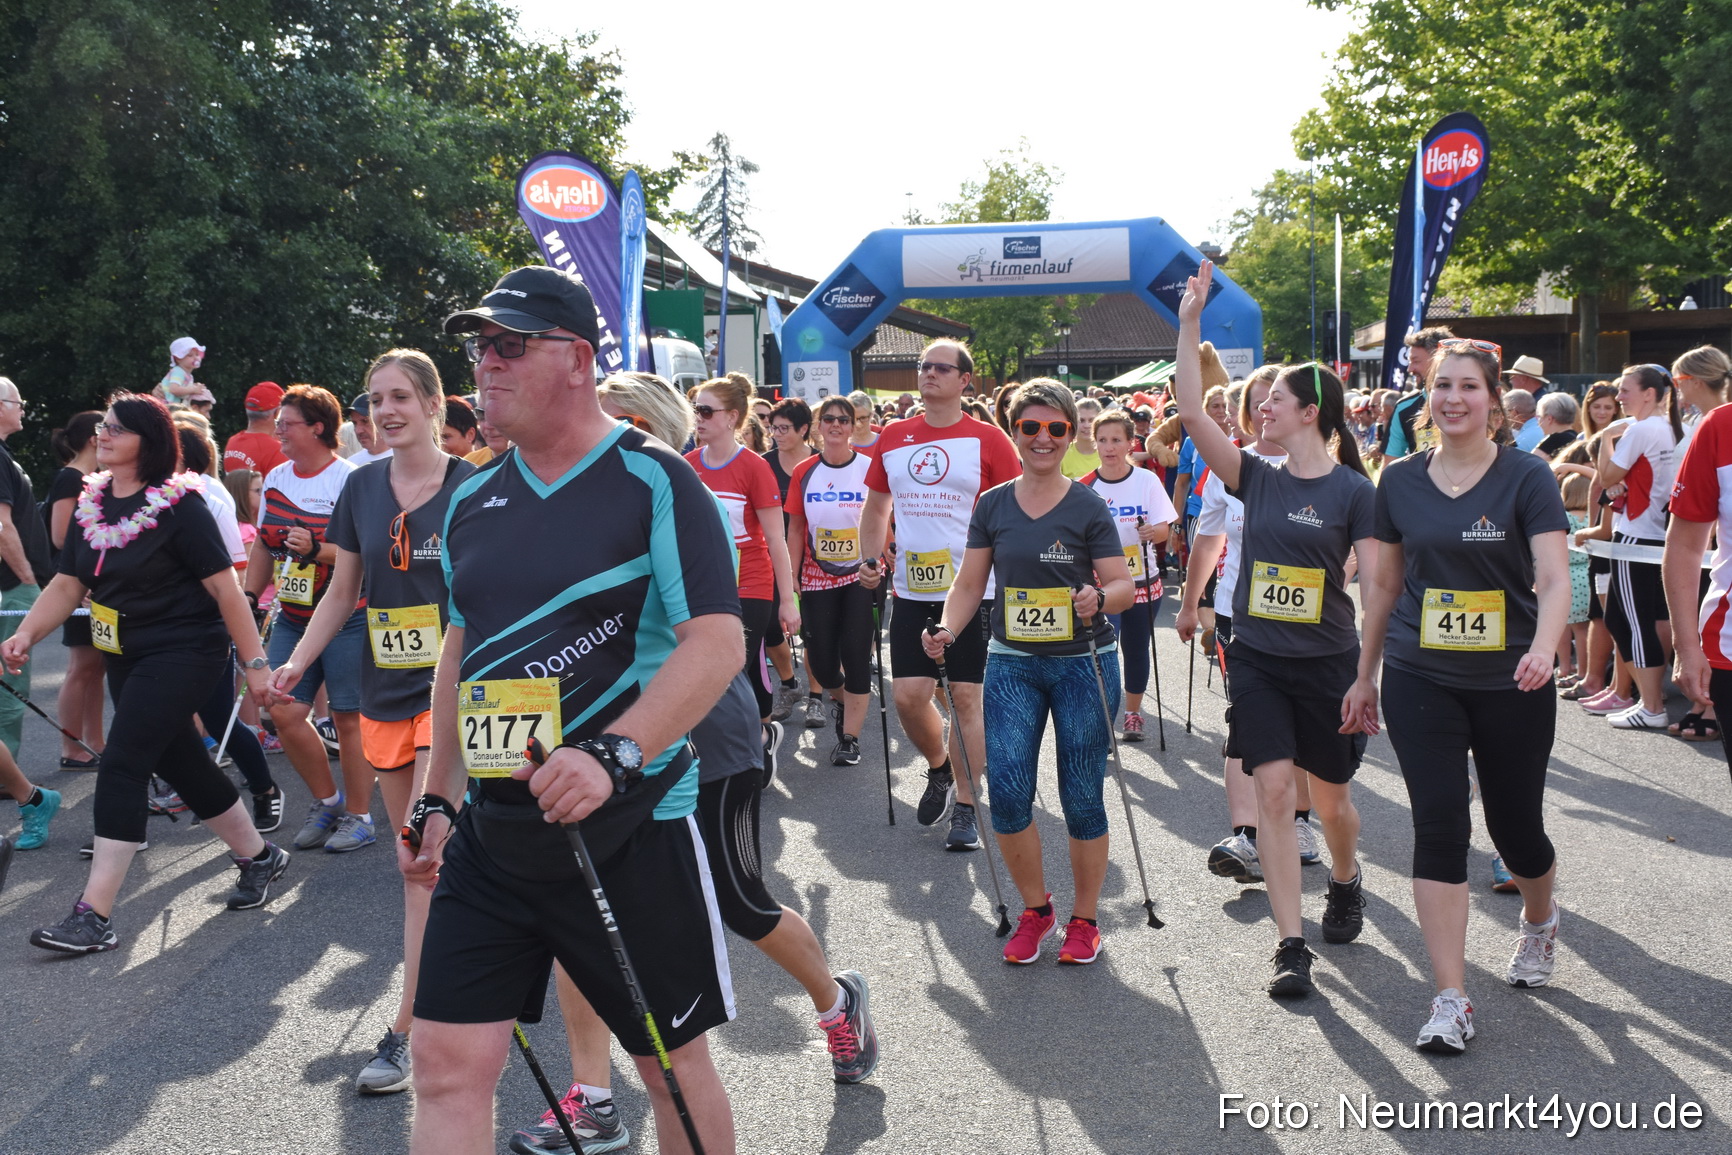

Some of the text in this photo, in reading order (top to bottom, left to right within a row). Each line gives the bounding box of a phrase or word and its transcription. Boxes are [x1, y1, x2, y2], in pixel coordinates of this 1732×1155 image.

[1426, 144, 1479, 174] Hervis
[1010, 244, 1039, 252] Fischer
[990, 258, 1074, 275] firmenlauf
[831, 293, 876, 304] Fischer
[896, 491, 919, 499] LAUFEN
[1288, 512, 1323, 525] BURKHARDT
[820, 540, 853, 552] 2073
[910, 564, 945, 581] 1907
[1263, 584, 1305, 607] 406
[1260, 603, 1290, 613] Engelmann
[1017, 608, 1056, 626] 424
[1438, 612, 1486, 634] 414
[382, 629, 423, 652] 413
[524, 613, 624, 679] Donauer
[505, 702, 552, 712] walk 2019
[465, 714, 542, 749] 2177
[473, 751, 524, 760] Donauer Diet
[495, 760, 521, 768] Donauer
[592, 887, 619, 932] LEKI
